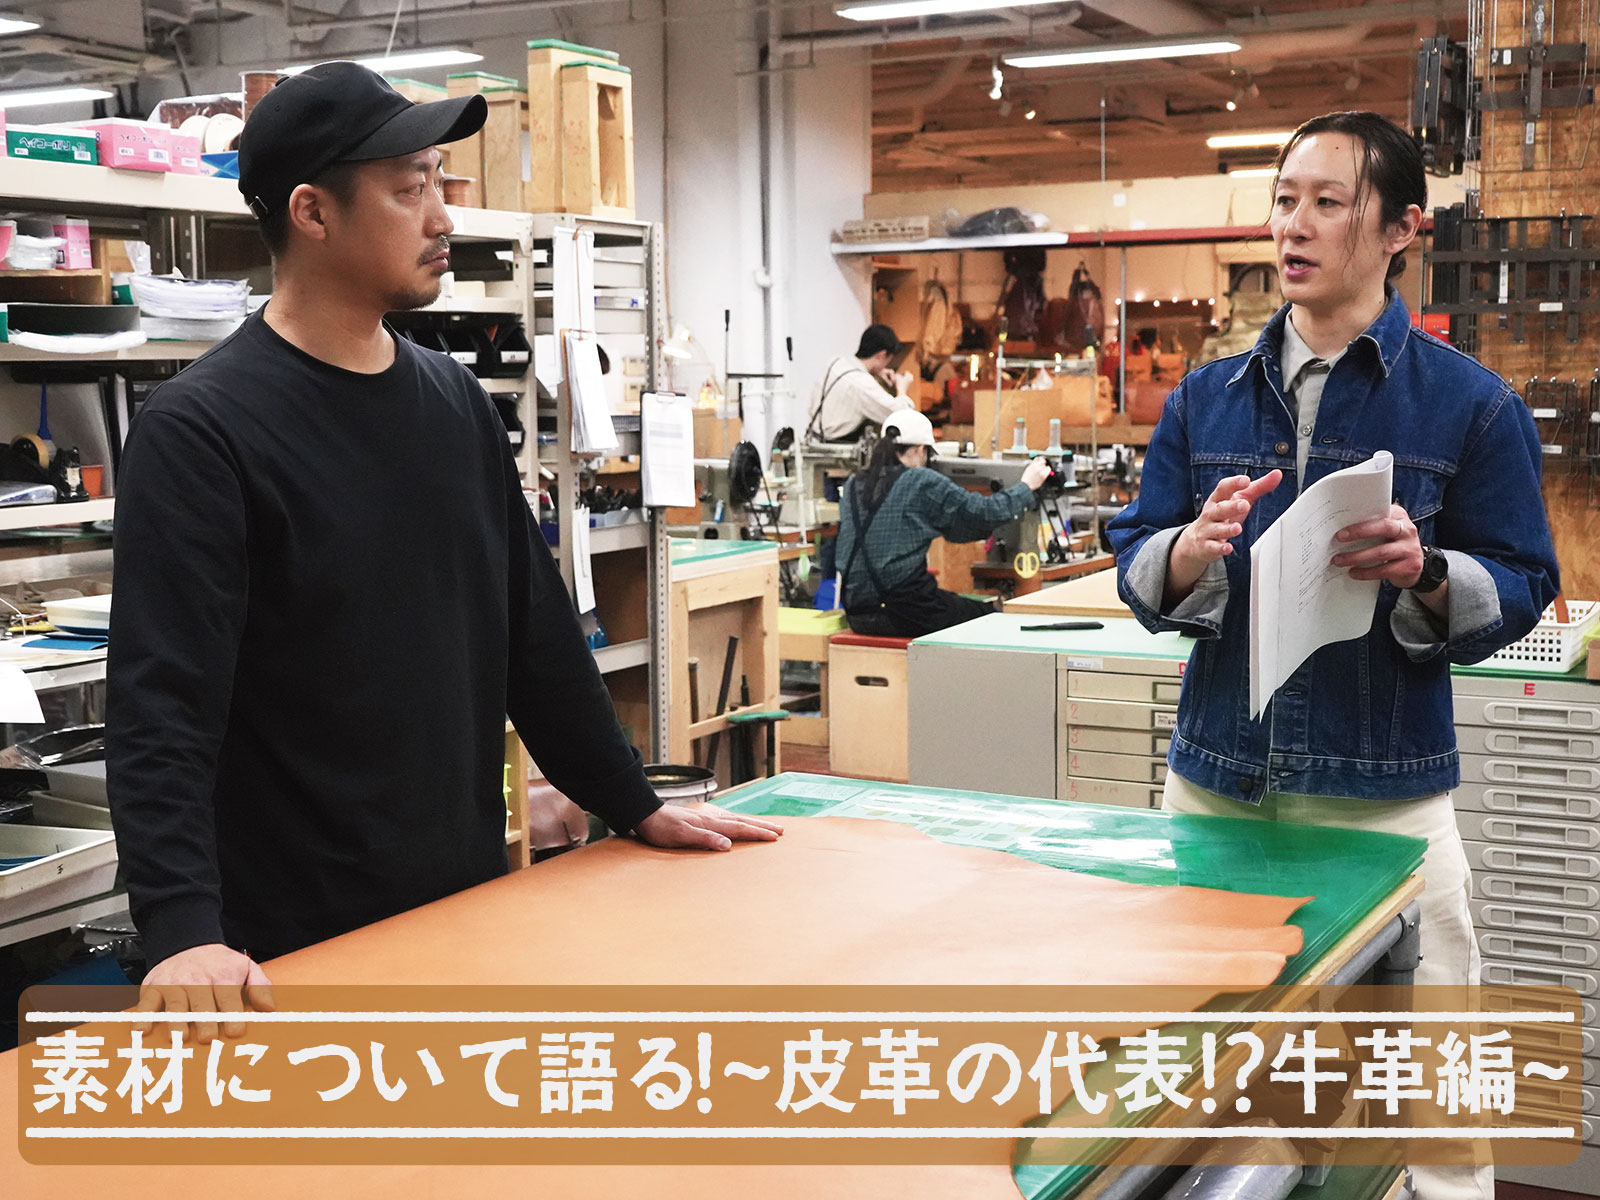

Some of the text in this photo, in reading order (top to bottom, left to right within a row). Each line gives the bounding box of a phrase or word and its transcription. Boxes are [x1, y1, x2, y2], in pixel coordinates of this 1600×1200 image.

[1524, 683, 1535, 696] E
[1070, 703, 1078, 720] 2
[1070, 726, 1079, 743] 3
[1070, 755, 1080, 771] 4
[1070, 781, 1080, 799] 5
